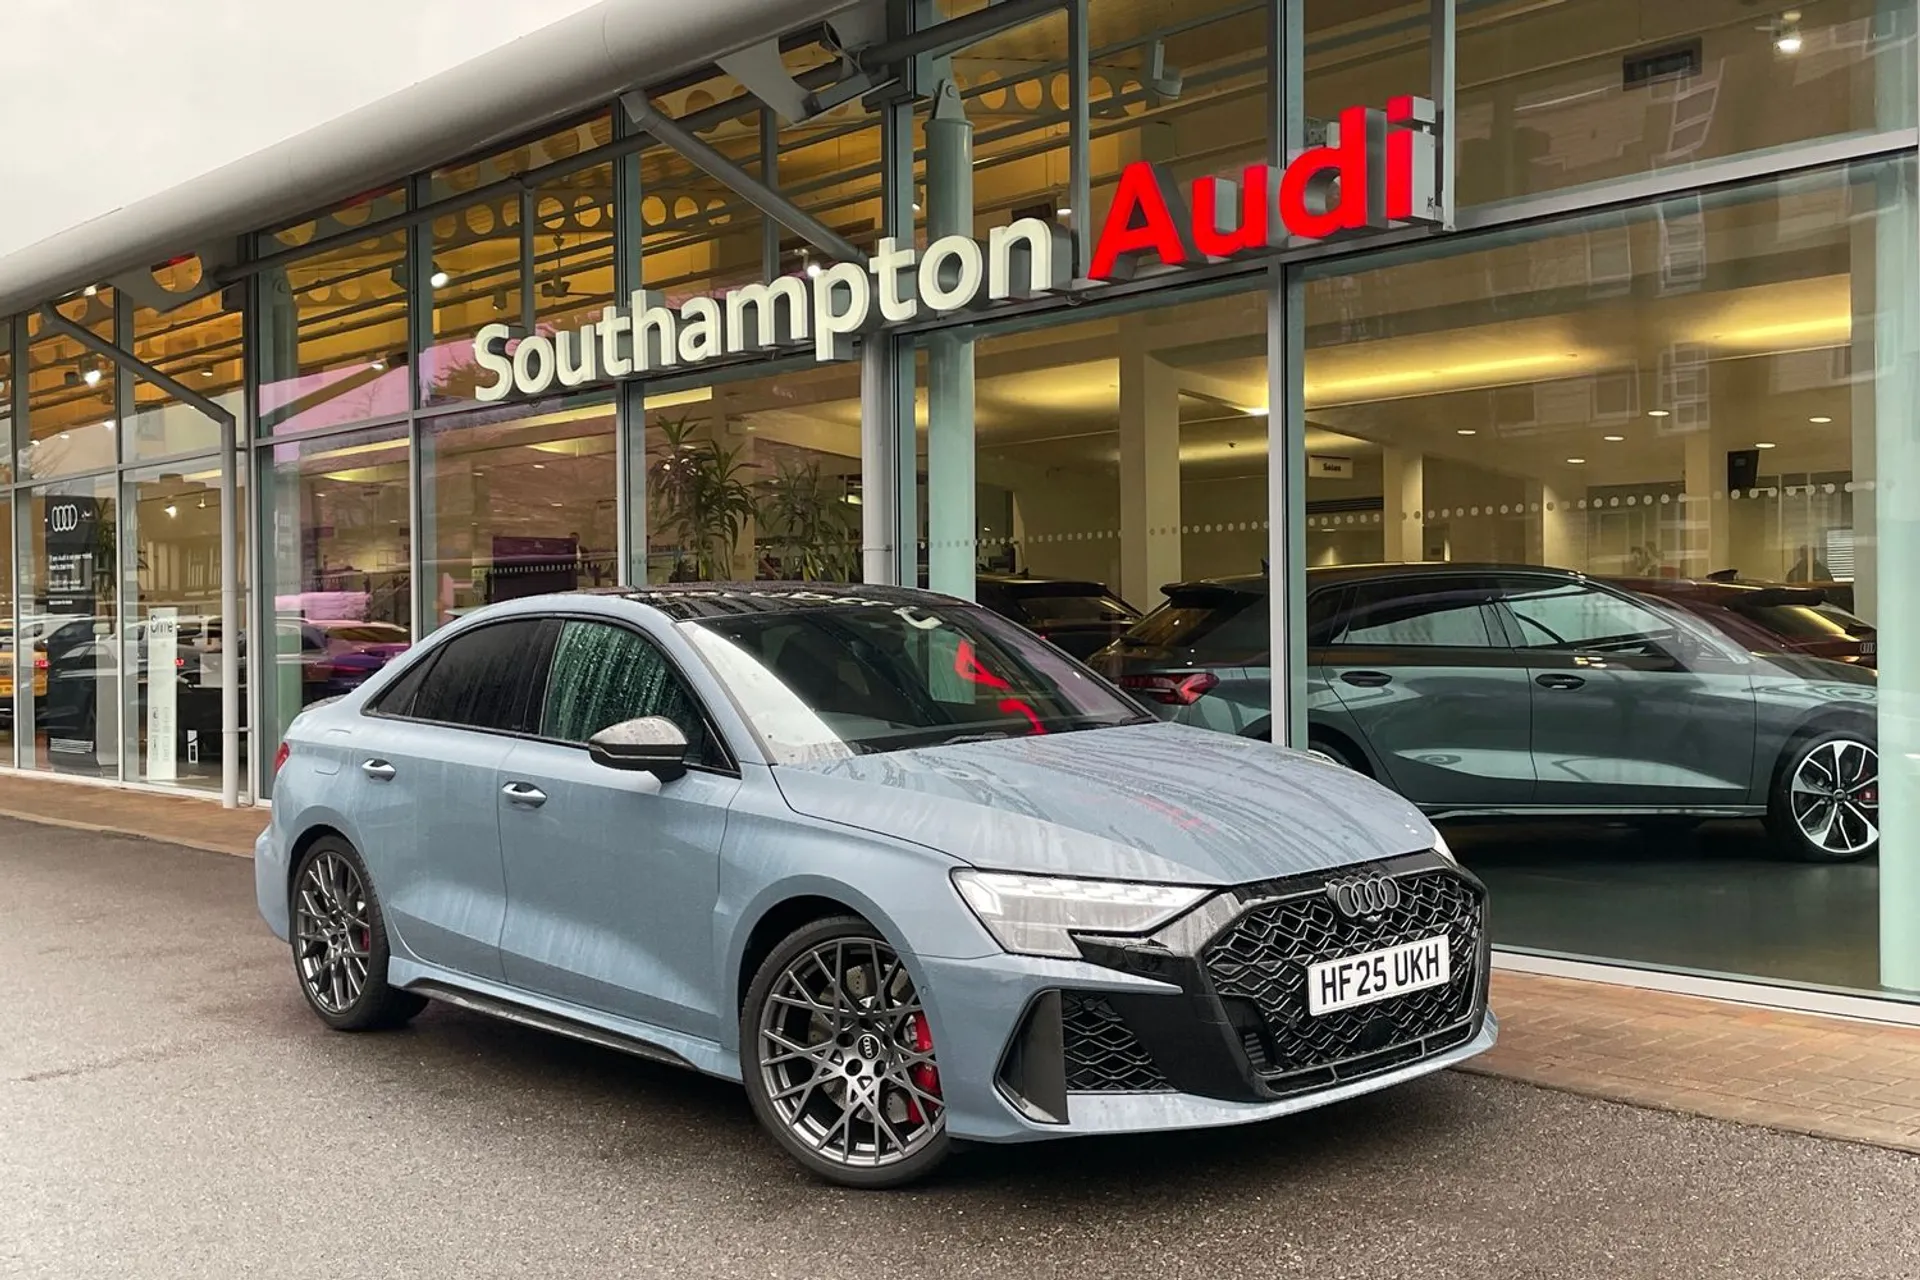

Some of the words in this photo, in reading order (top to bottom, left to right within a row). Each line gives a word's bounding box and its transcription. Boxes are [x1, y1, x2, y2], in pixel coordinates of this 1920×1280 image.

[474, 217, 1054, 401] Southampton
[1087, 95, 1413, 280] Audi
[1321, 956, 1387, 1005] HF25
[1394, 943, 1439, 986] UKH
